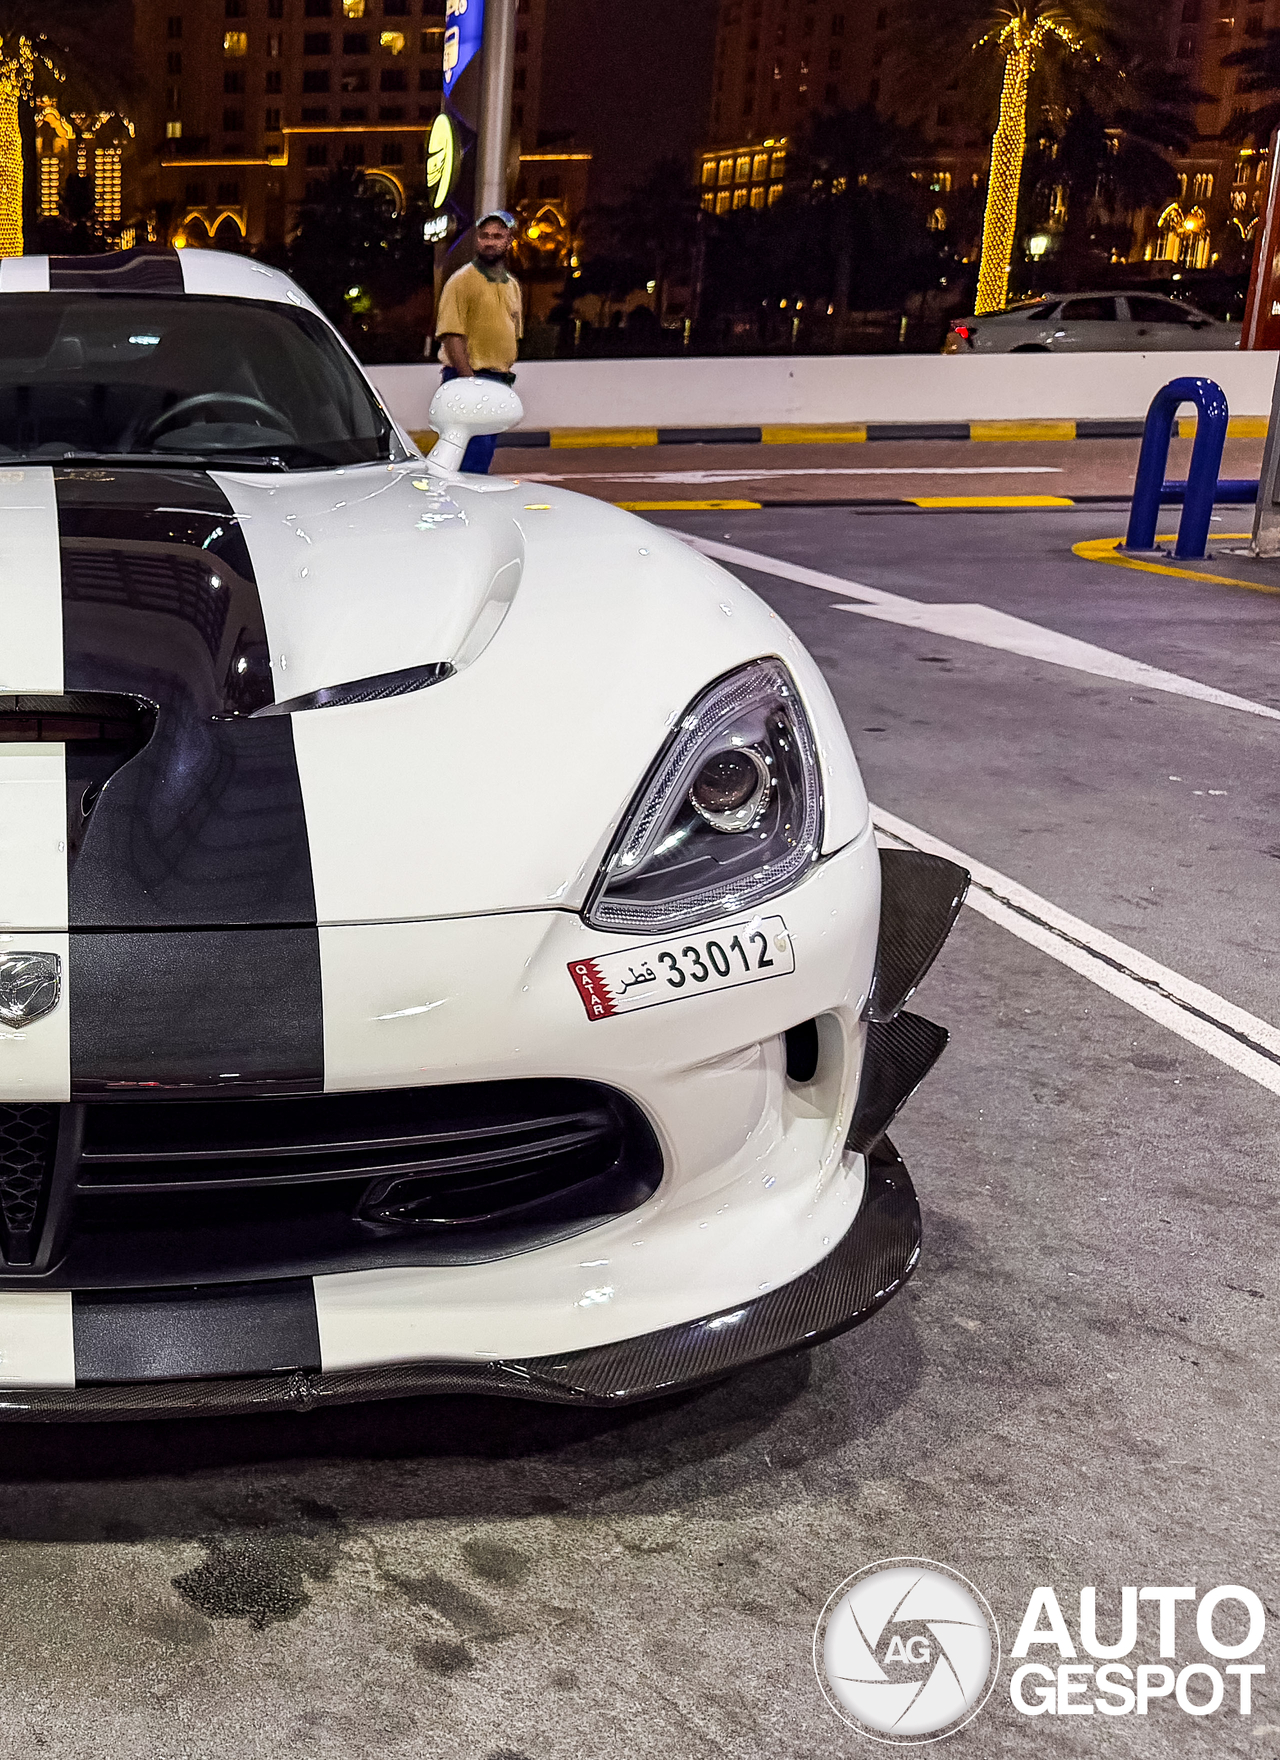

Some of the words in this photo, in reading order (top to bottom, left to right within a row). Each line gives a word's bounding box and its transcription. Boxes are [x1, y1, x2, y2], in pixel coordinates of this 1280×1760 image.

[615, 961, 657, 995] قطر
[657, 931, 774, 988] 33012
[574, 964, 605, 1016] QATAR
